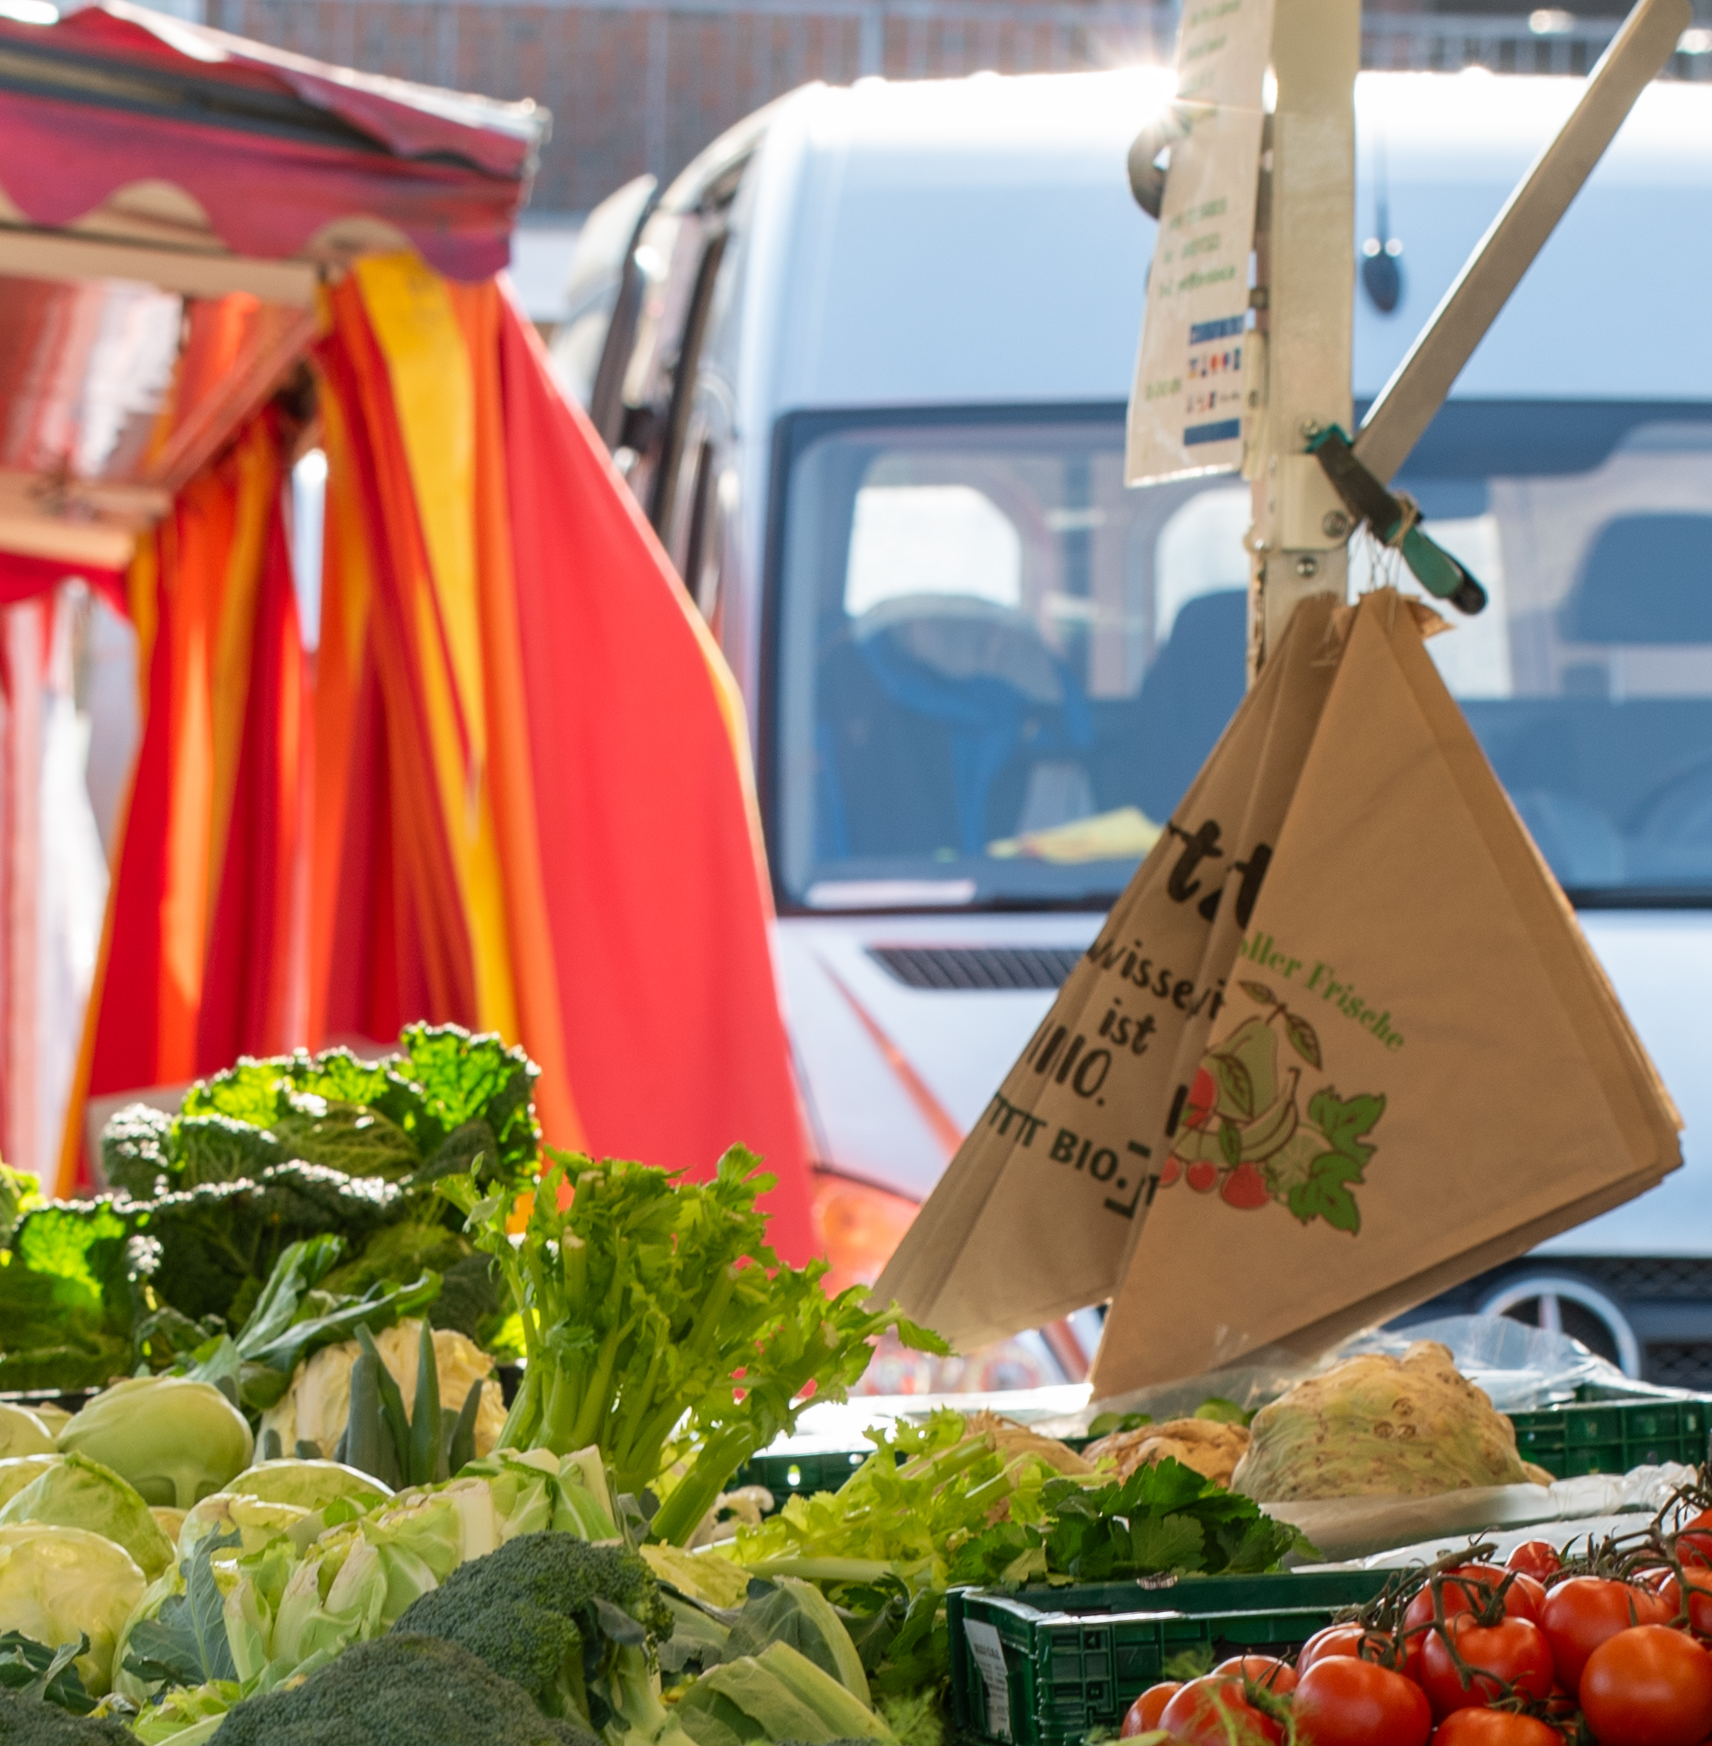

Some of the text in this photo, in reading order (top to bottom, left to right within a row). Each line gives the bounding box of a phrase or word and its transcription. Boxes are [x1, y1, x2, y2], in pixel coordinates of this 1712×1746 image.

[1099, 997, 1157, 1057] ist
[1305, 960, 1406, 1053] Frische
[1049, 1127, 1128, 1191] BIO.
